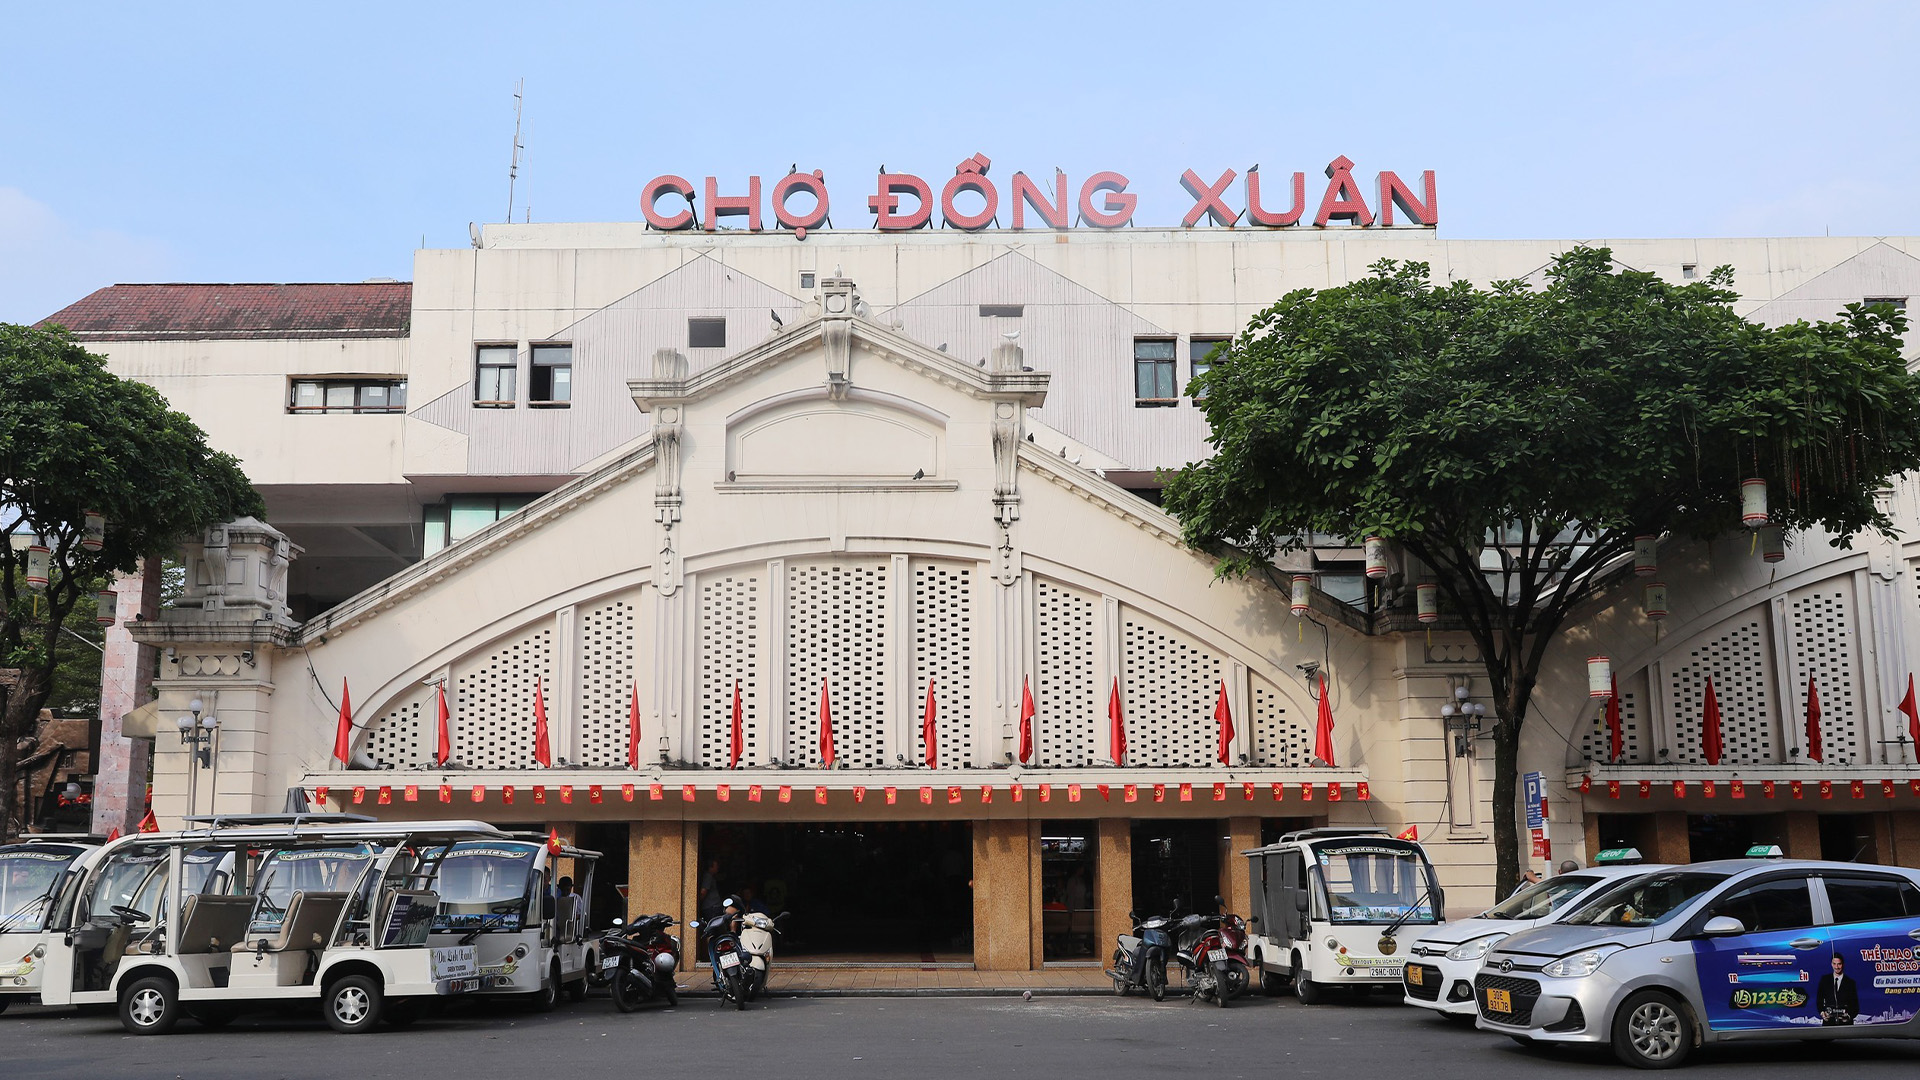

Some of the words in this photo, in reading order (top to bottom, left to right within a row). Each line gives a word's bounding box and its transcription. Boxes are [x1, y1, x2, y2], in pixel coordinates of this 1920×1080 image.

[641, 169, 829, 241] CHỢ
[868, 152, 1138, 231] ĐỒNG
[1179, 155, 1438, 227] XUÂN
[1528, 781, 1537, 803] P
[1602, 849, 1621, 858] Grab
[1751, 845, 1768, 853] Grab
[1881, 948, 1912, 961] THAO
[1898, 961, 1918, 972] CAO
[1492, 989, 1503, 1000] 30E
[1490, 1000, 1509, 1012] 921.78
